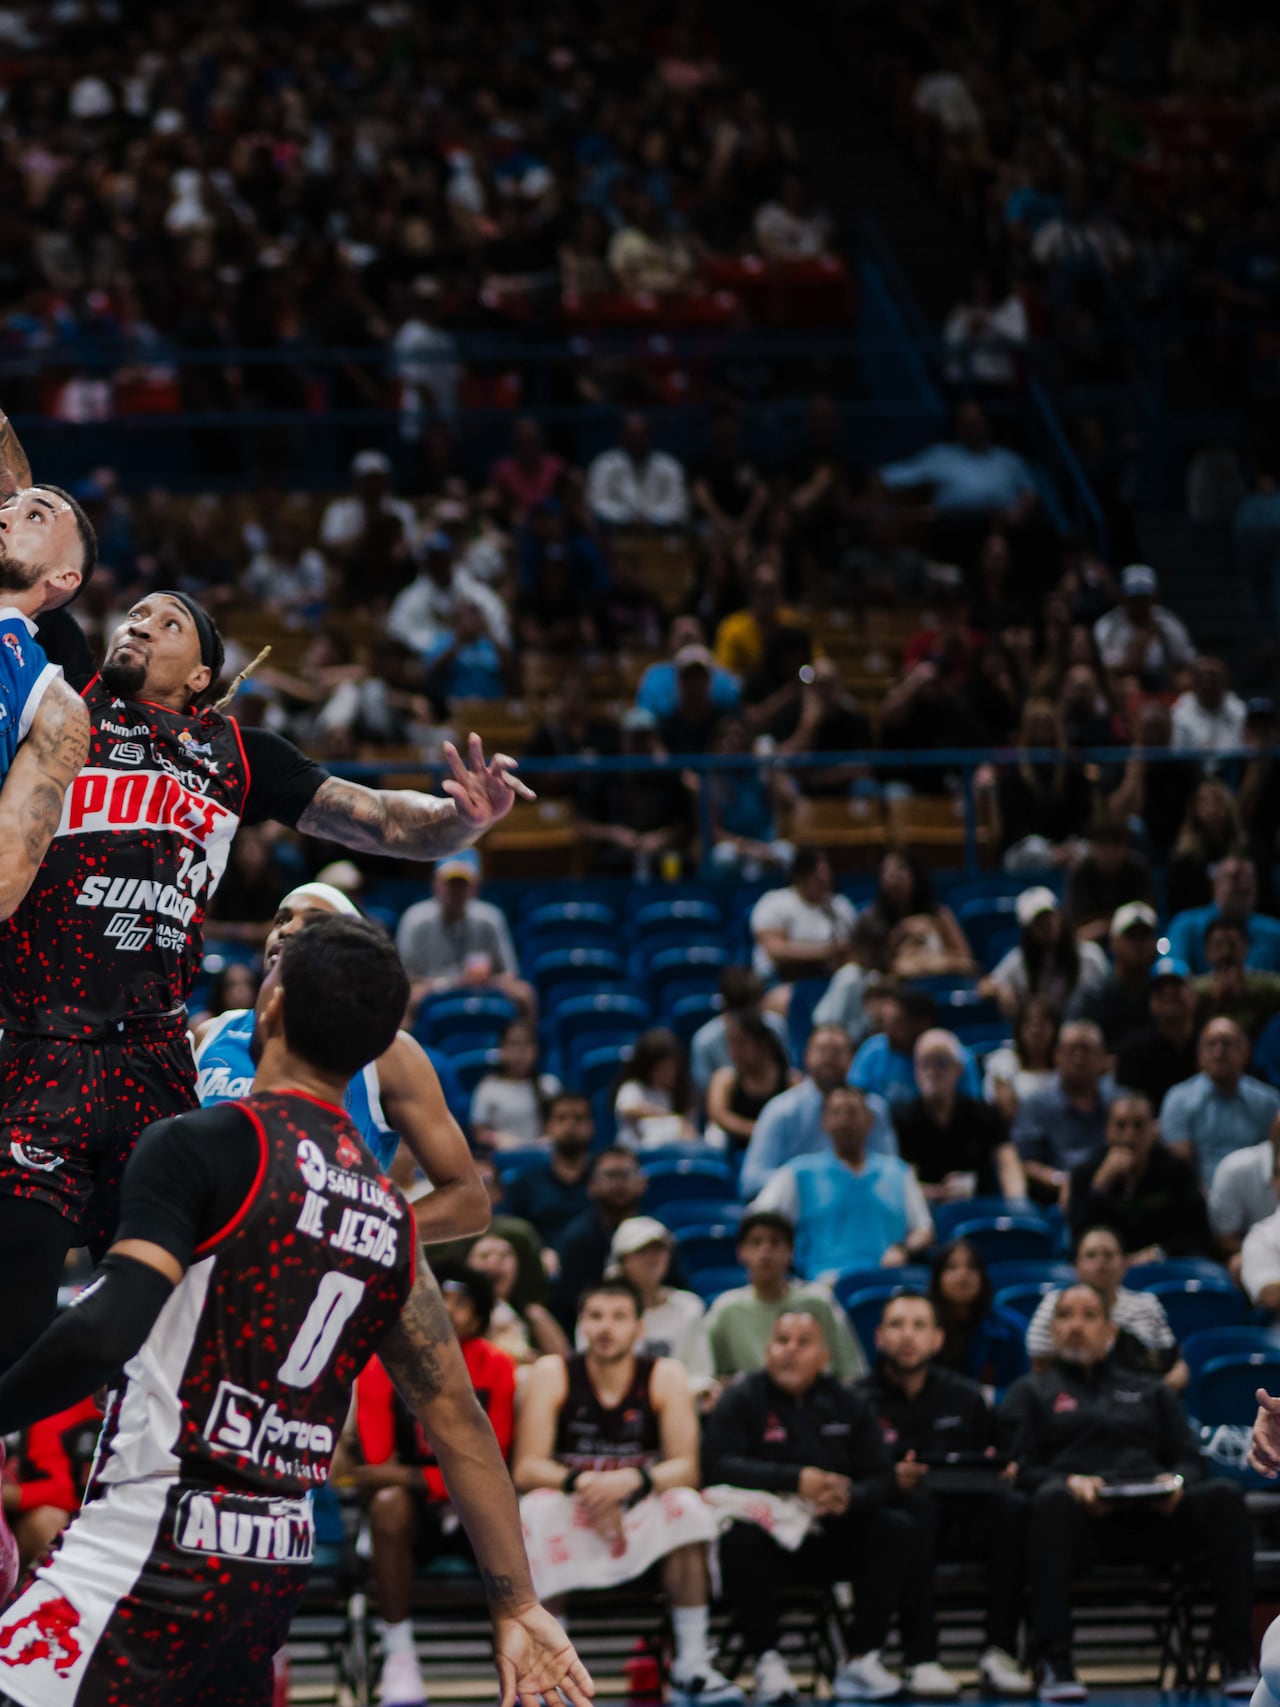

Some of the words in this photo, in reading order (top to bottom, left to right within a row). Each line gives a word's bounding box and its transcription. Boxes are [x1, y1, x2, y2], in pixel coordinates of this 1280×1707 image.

[69, 774, 228, 842] PONCE
[327, 1169, 359, 1199] SAN
[296, 1189, 329, 1239] DE
[277, 1270, 367, 1389] 0
